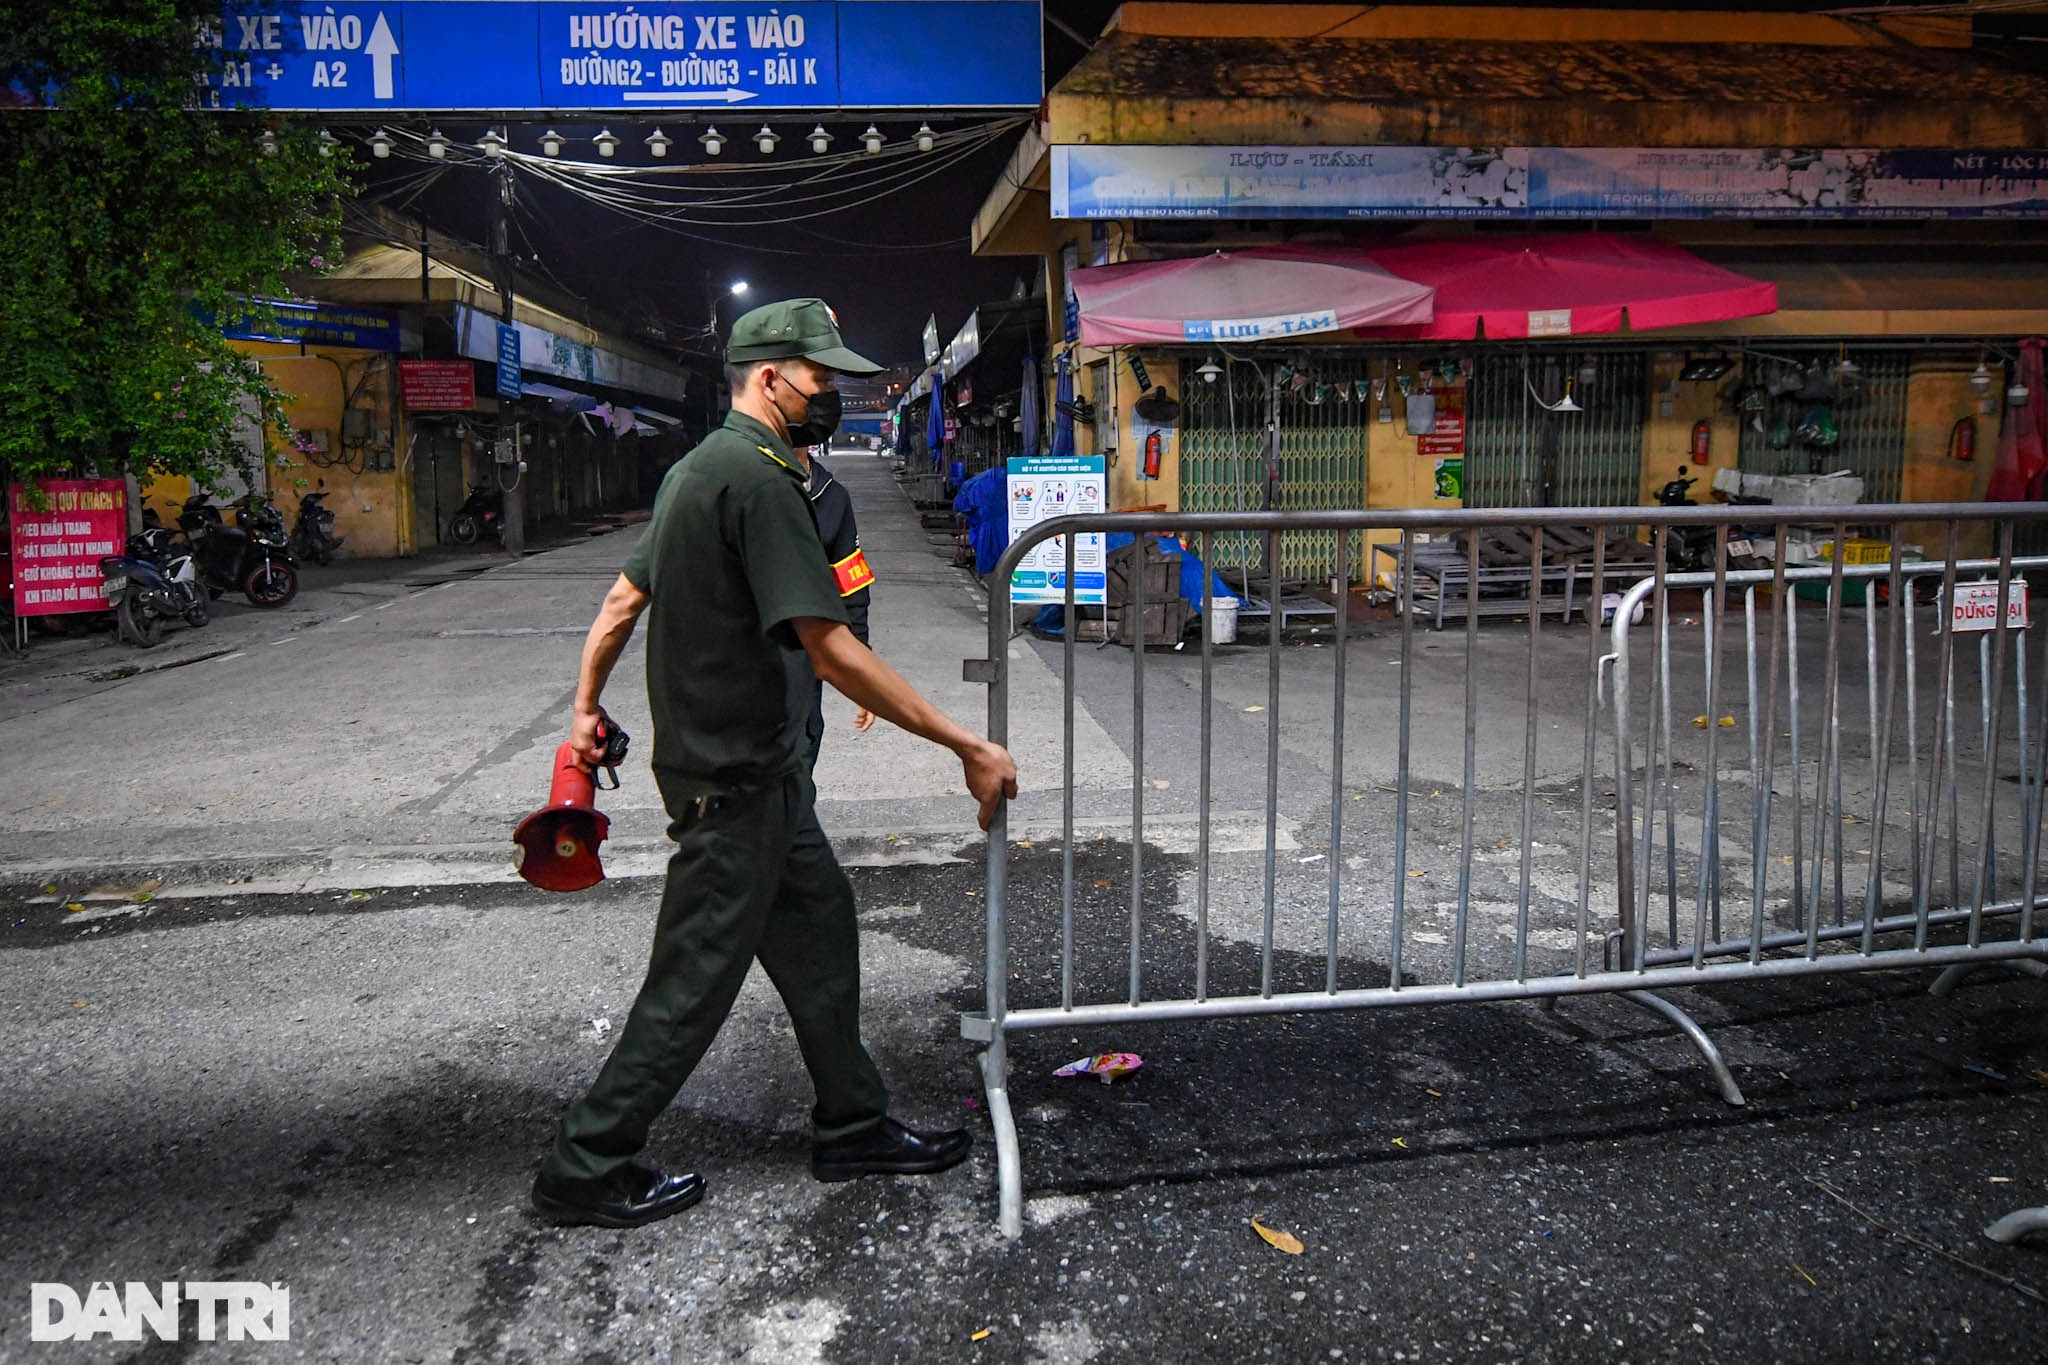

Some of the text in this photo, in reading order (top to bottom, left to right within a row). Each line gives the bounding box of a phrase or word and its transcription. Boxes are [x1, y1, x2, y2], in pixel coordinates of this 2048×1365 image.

[237, 15, 283, 50] XE
[301, 5, 363, 50] VÀO
[569, 5, 806, 50] HƯỚNG XE VÀO
[222, 60, 253, 88] A1
[311, 60, 348, 88] A2
[560, 50, 644, 87] ĐƯỜNG2
[660, 51, 740, 87] ĐƯỜNG3
[763, 52, 798, 86] BÃI
[803, 57, 818, 85] K
[80, 487, 113, 511] KHÁCH
[1953, 600, 1997, 620] DỪNG
